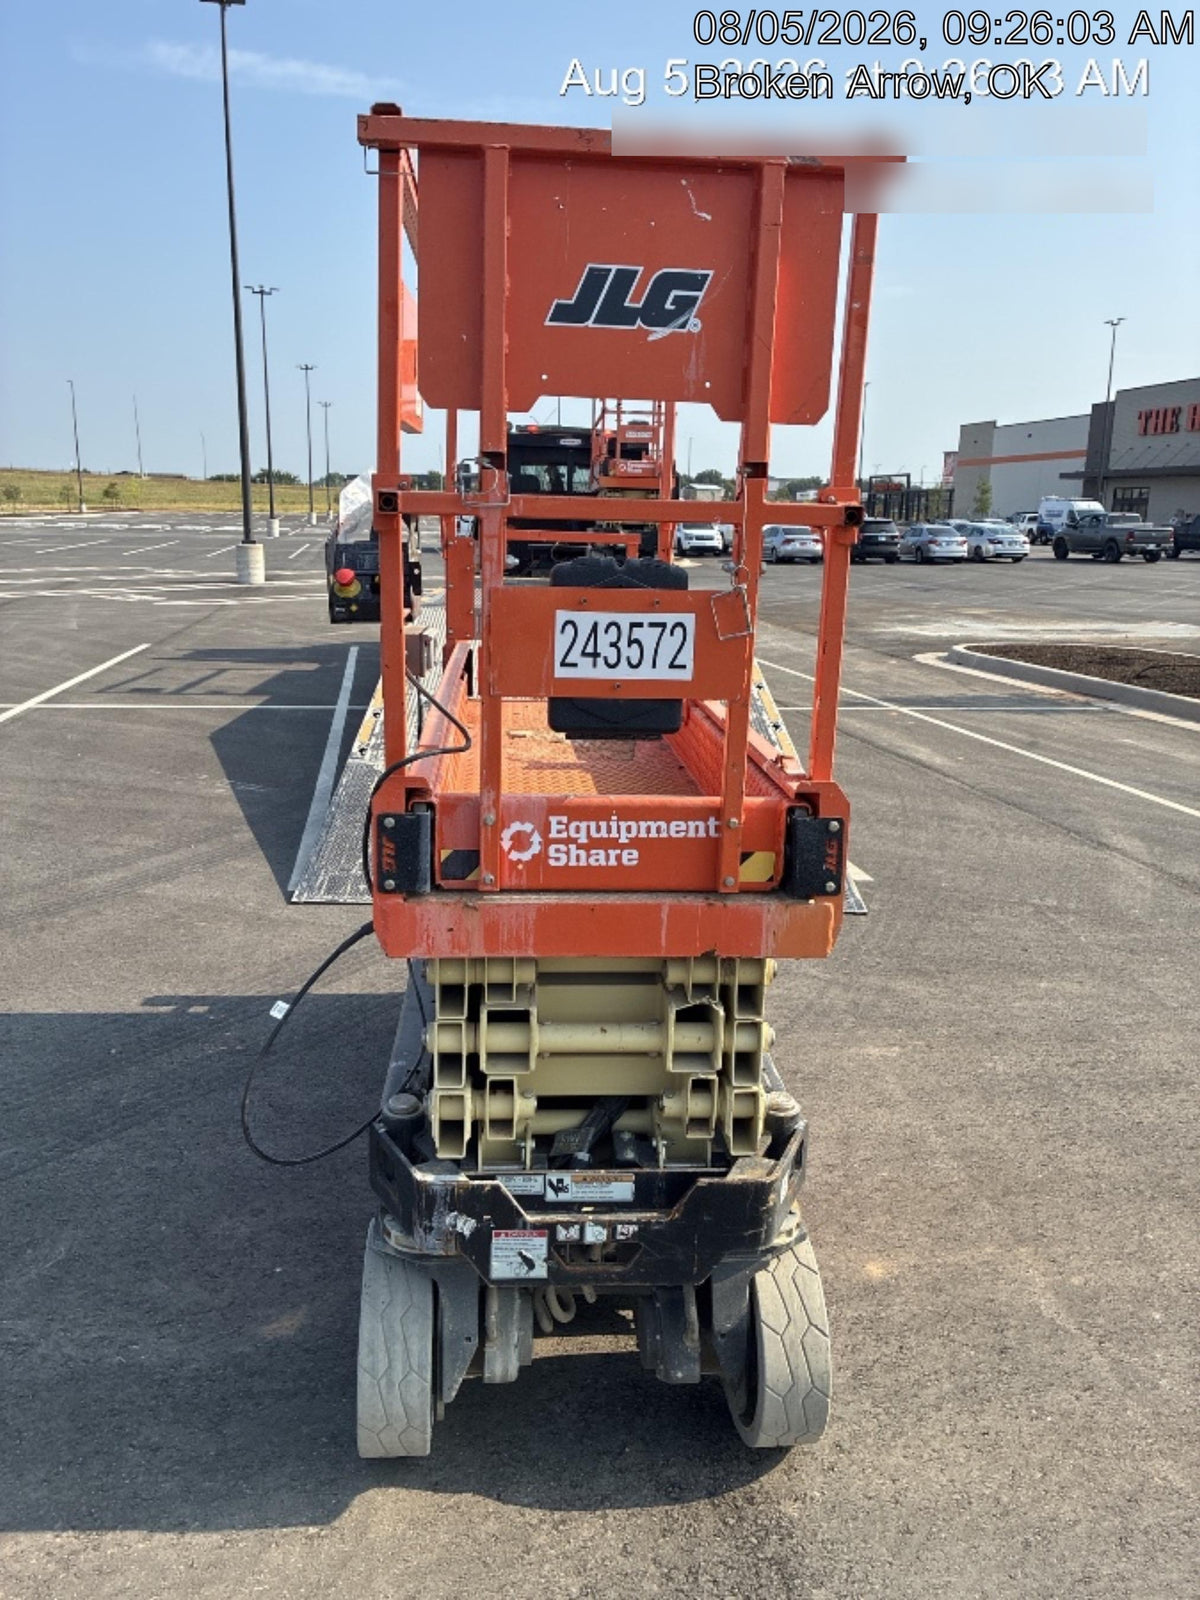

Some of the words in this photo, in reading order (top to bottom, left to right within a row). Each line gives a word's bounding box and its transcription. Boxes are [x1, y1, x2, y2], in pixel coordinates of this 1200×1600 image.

[544, 263, 714, 333] JLG
[1138, 407, 1180, 436] THE
[559, 620, 687, 669] 243572
[548, 815, 721, 843] Equipment
[548, 844, 639, 867] Share
